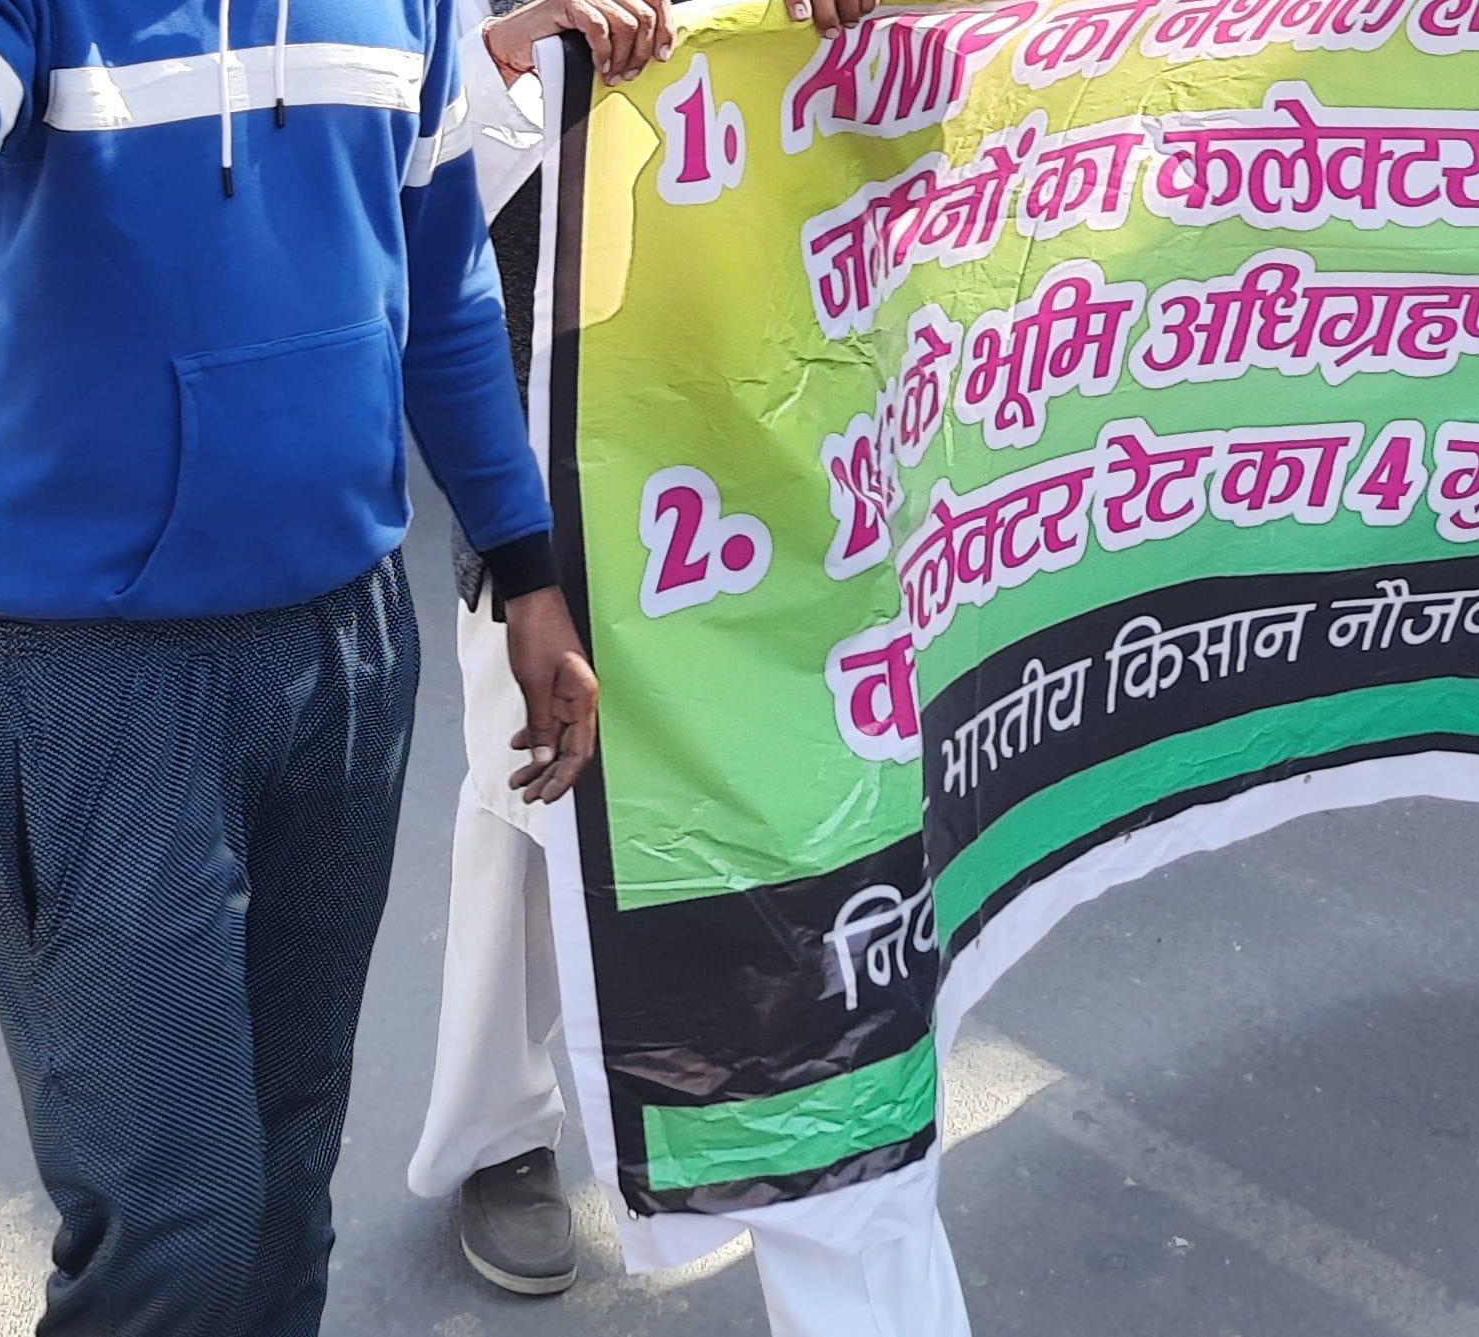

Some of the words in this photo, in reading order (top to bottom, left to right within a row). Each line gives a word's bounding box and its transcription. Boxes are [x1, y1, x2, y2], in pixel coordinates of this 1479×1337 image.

[673, 76, 739, 185] 1.
[1027, 132, 1143, 221] का
[653, 483, 758, 596] 2.
[964, 276, 1134, 432] भूमि
[1105, 436, 1208, 534] रेट
[1221, 435, 1351, 510] का
[1360, 436, 1414, 511] 4
[941, 658, 1093, 800] भारतीय
[1105, 601, 1316, 716] किसान
